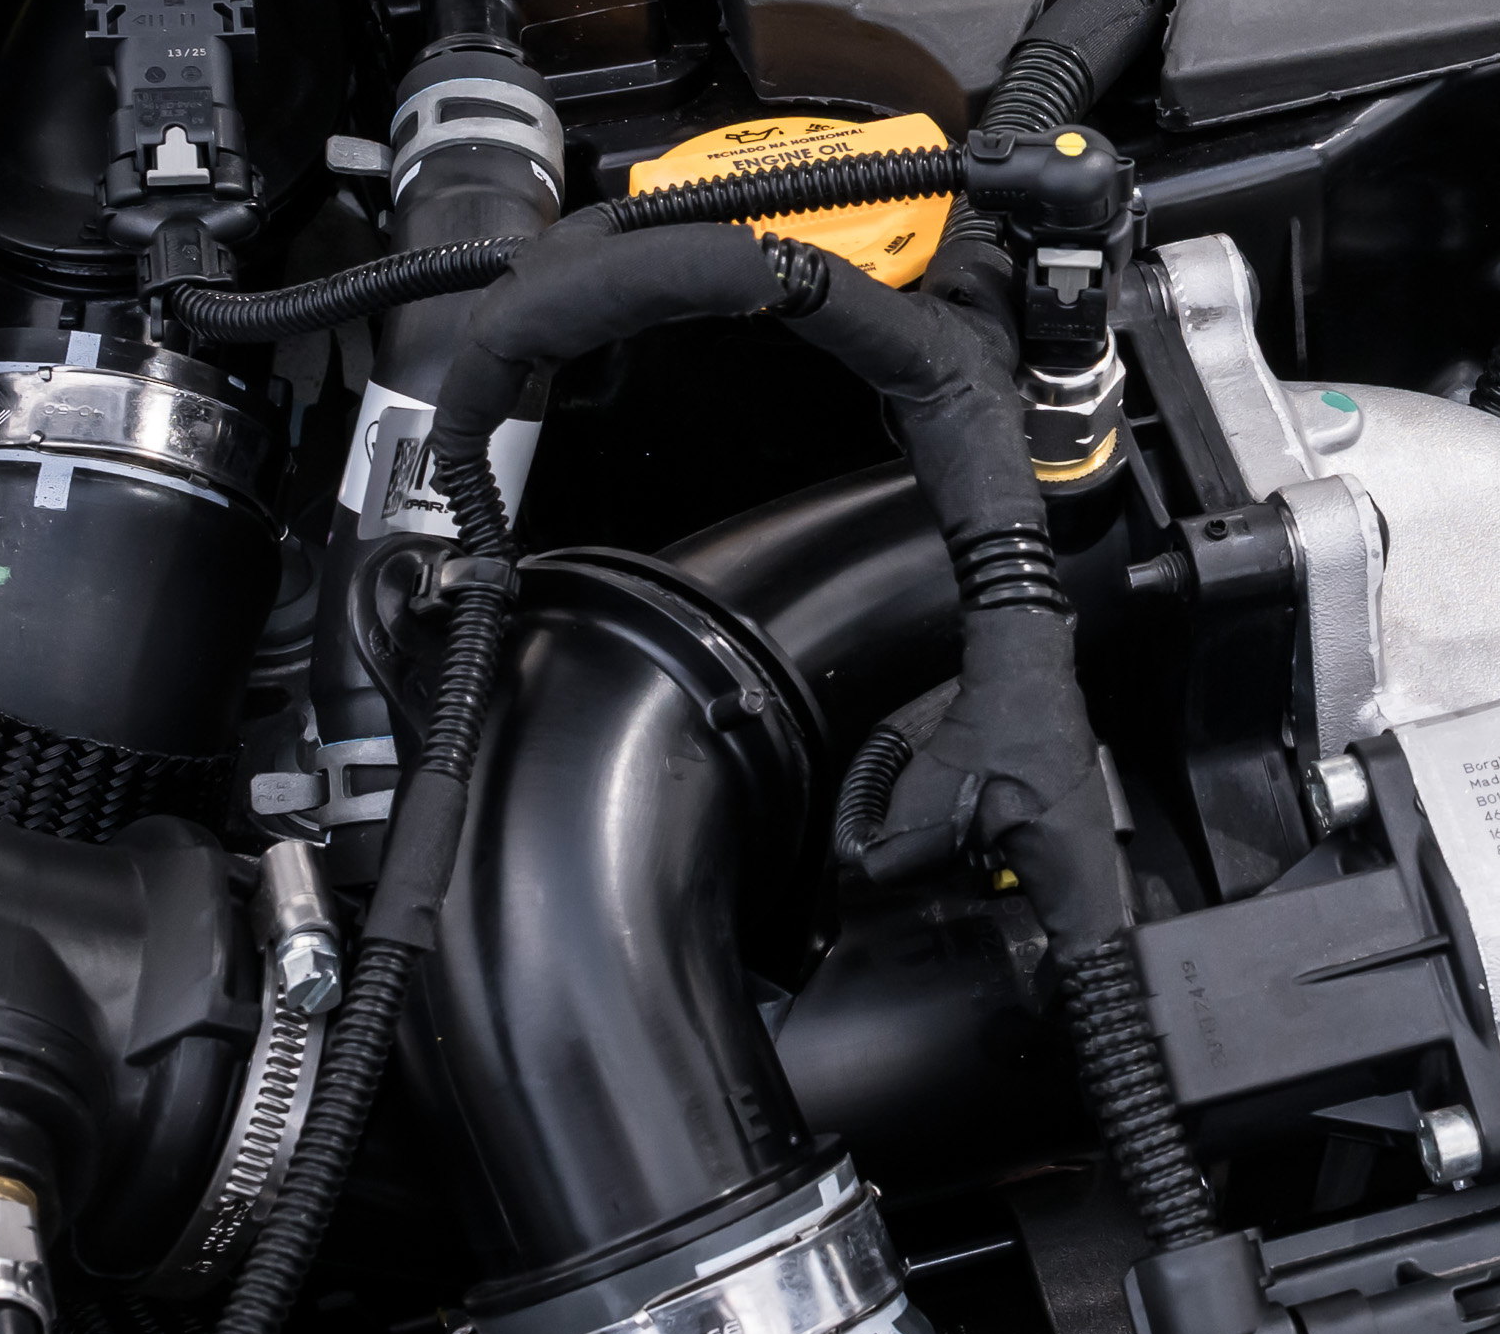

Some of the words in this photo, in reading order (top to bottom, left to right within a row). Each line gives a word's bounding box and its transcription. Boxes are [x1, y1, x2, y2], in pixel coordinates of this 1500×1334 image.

[167, 48, 207, 58] 13/25
[769, 140, 789, 150] NA
[790, 128, 865, 146] HORIZONTAL
[732, 148, 814, 171] ENGINE
[818, 142, 854, 157] OIL
